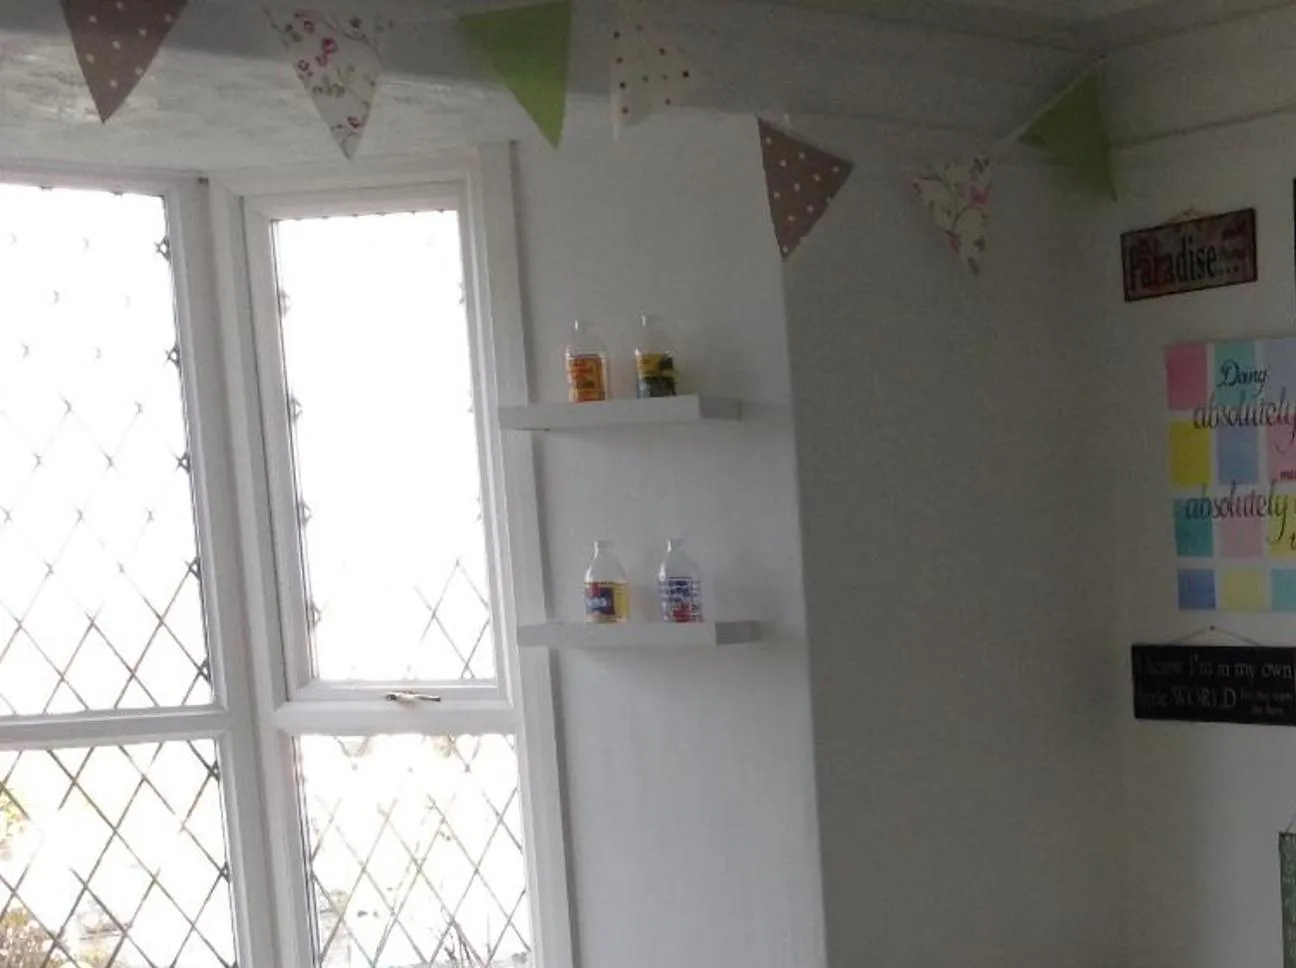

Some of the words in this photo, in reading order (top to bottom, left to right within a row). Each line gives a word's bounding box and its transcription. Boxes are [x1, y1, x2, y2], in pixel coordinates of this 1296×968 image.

[1216, 358, 1268, 395] Doing
[1184, 480, 1288, 545] absolutely
[1261, 662, 1293, 679] own
[1171, 685, 1238, 710] WORLD
